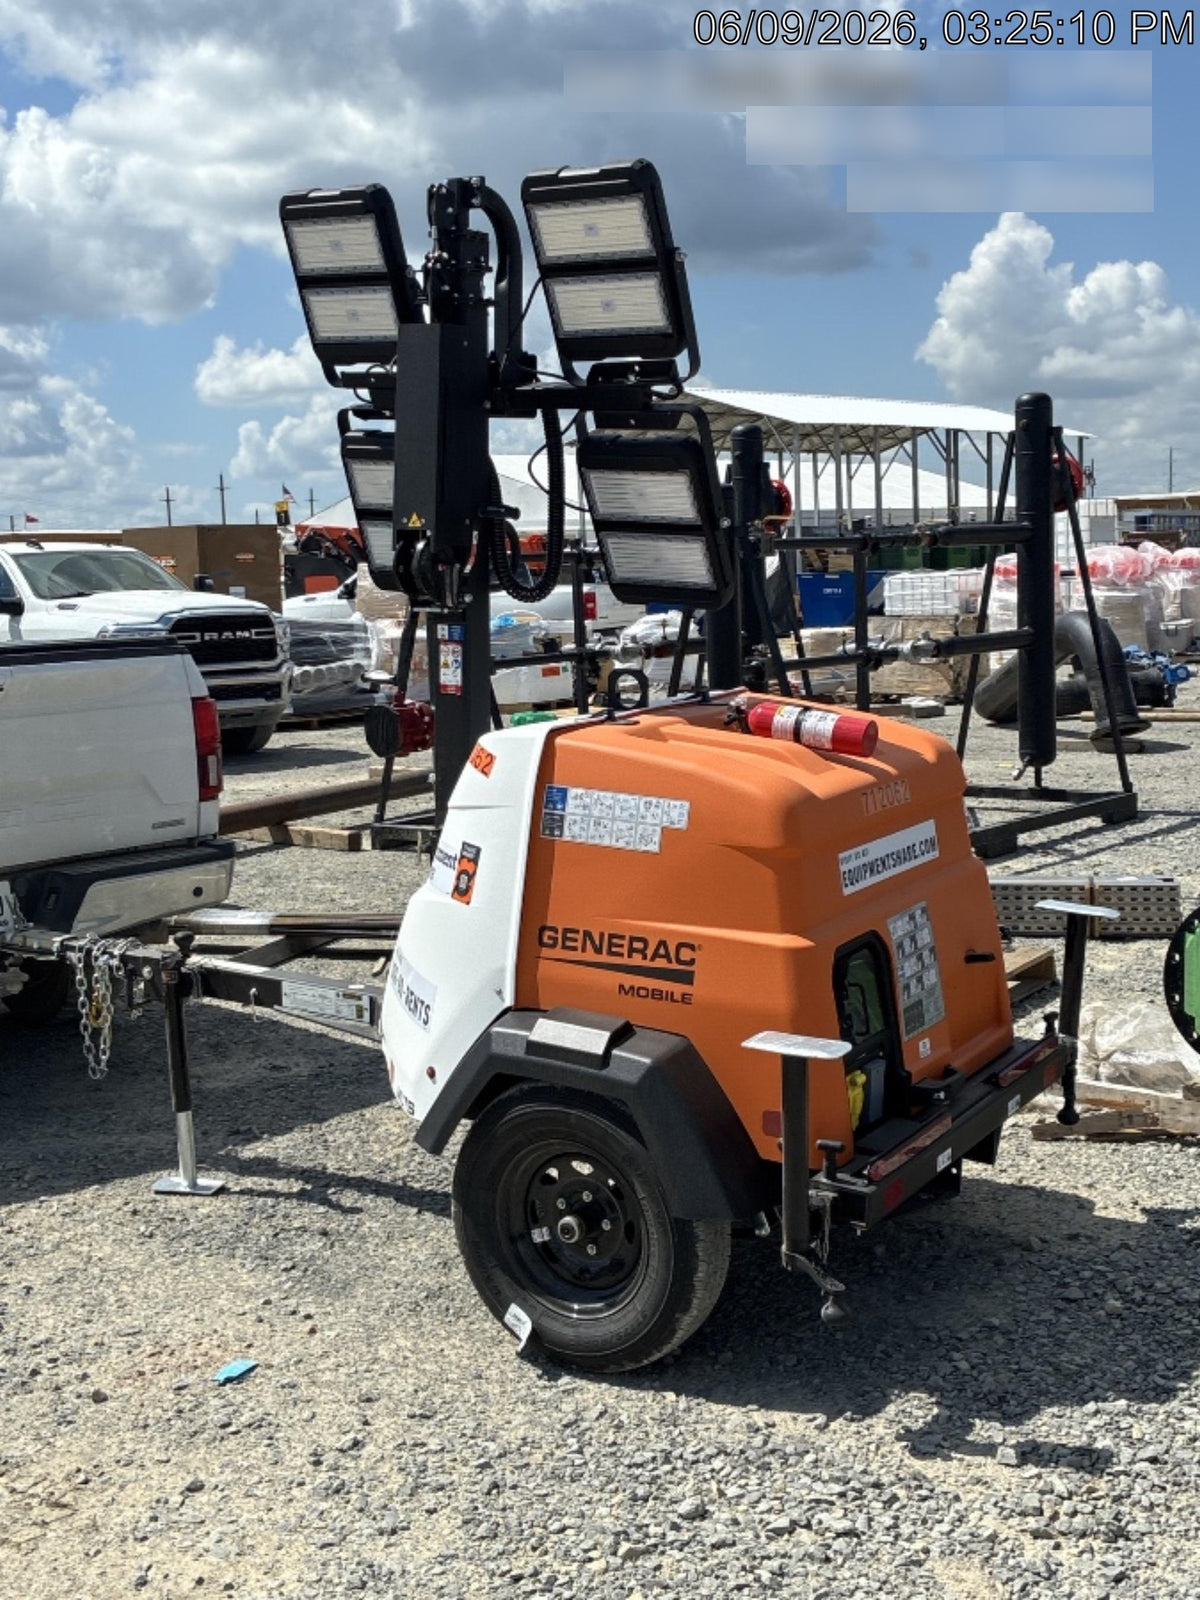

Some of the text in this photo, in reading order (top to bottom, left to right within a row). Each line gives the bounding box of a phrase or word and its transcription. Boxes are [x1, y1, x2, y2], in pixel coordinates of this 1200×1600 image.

[203, 630, 250, 641] RAM
[861, 779, 911, 815] 712062
[842, 835, 937, 888] EQUIPMENTSHARE.COM
[537, 924, 697, 967] GENERAC
[617, 983, 694, 1005] MOBILE
